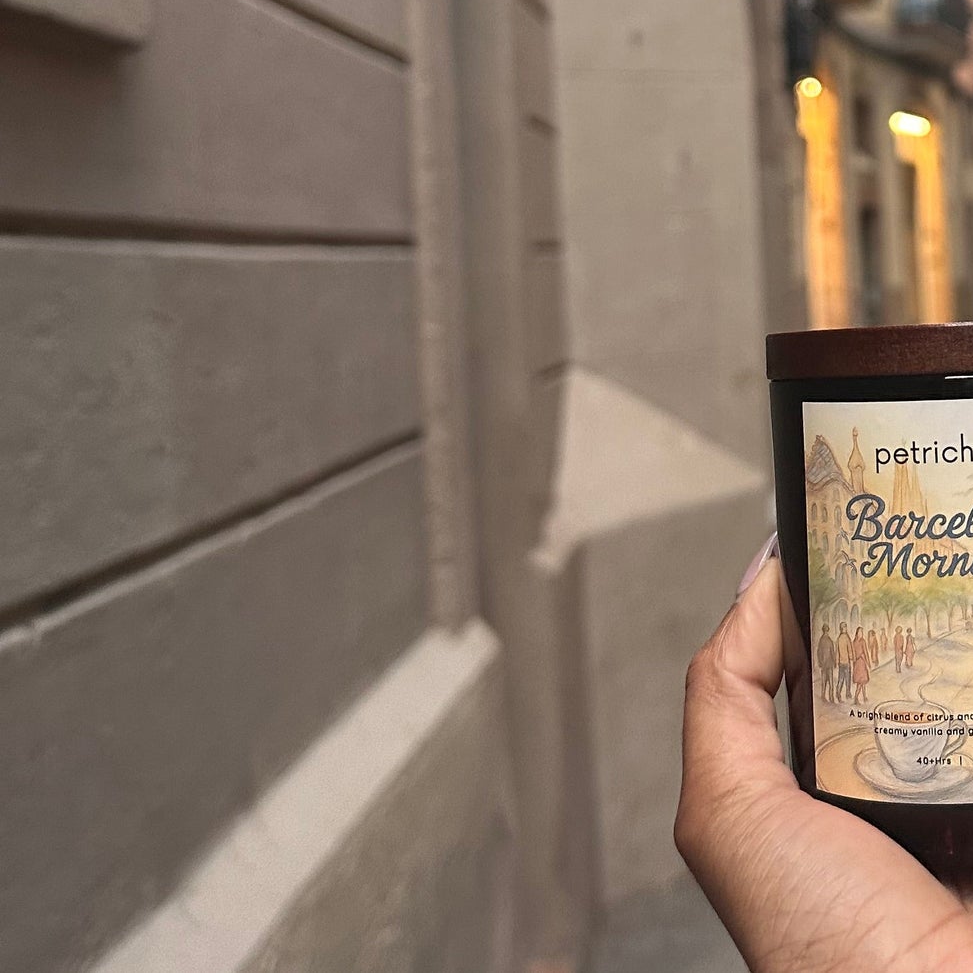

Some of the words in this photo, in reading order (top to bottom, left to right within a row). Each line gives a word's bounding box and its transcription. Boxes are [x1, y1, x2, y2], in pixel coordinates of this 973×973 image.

[857, 711, 882, 721] bright
[885, 712, 911, 721] blend
[913, 712, 924, 721] of
[926, 713, 954, 721] citrus
[874, 727, 908, 737] creamy
[911, 727, 943, 736] vanilla
[946, 727, 965, 736] and
[916, 757, 952, 765] 40+Hrs
